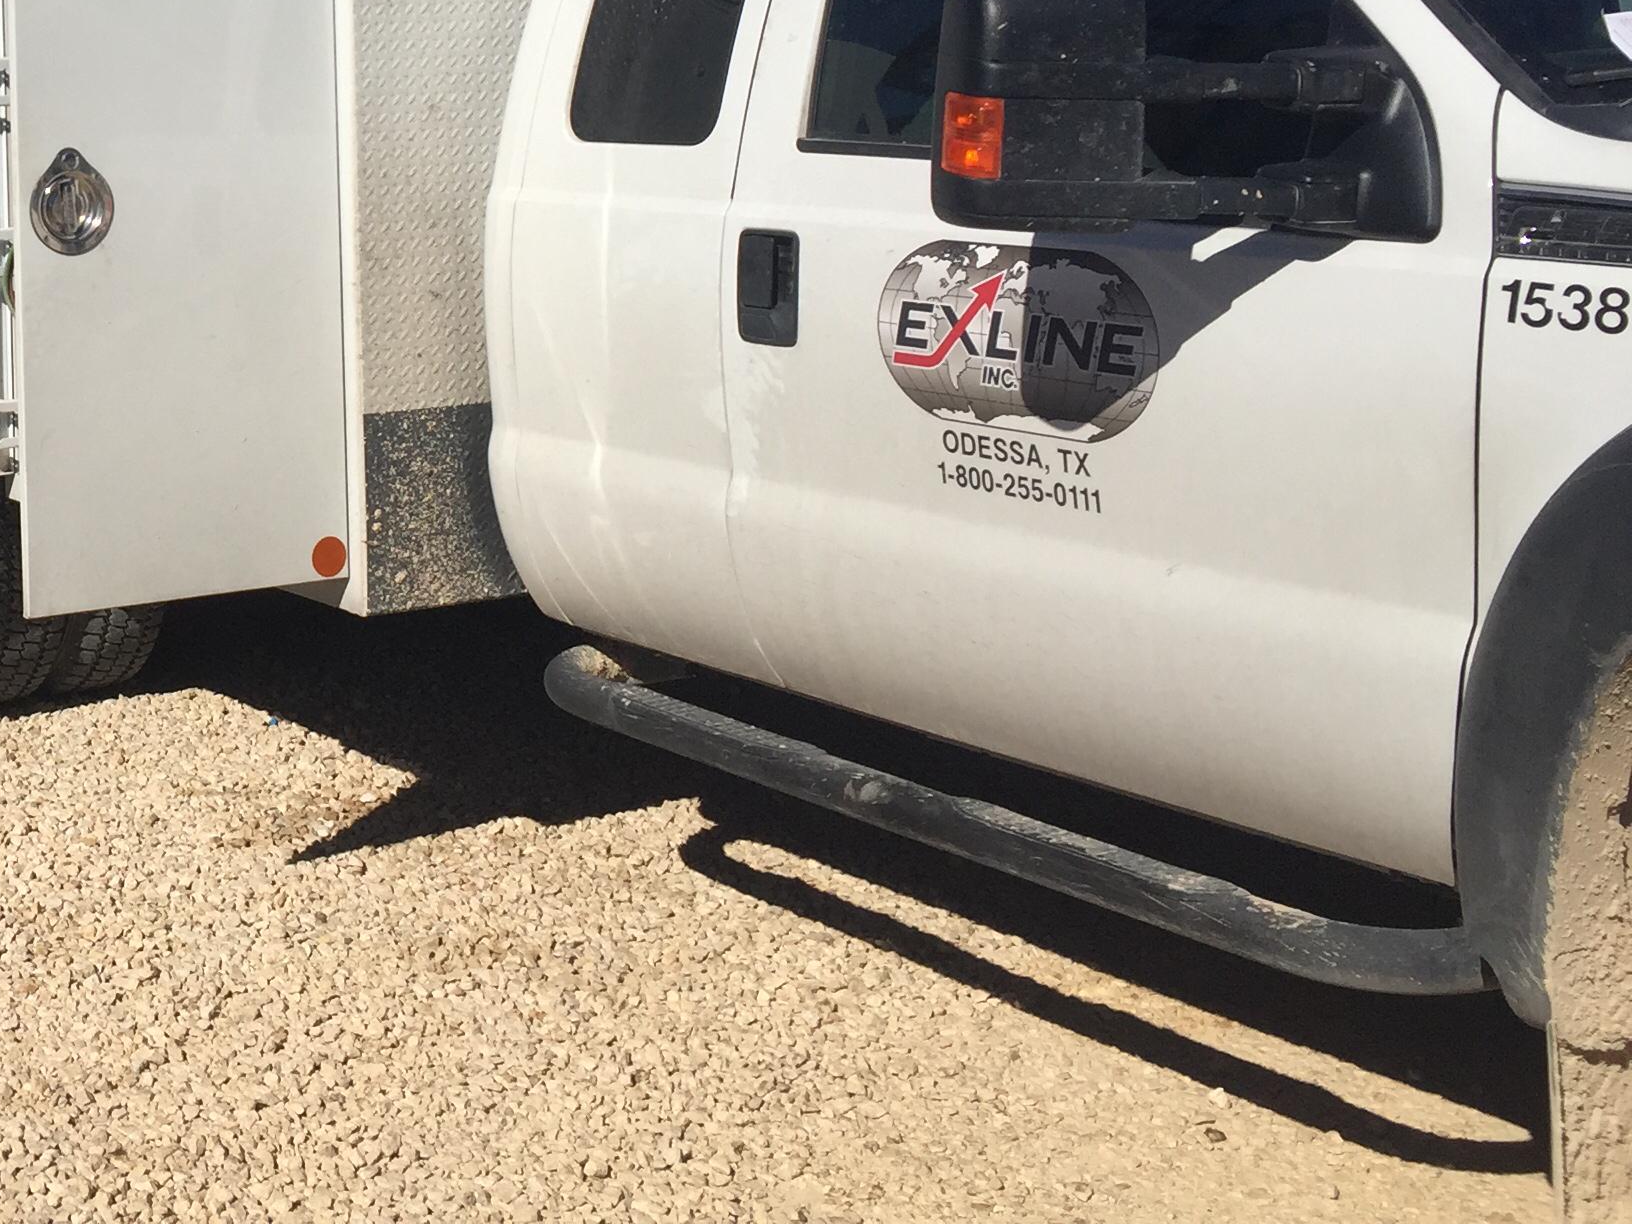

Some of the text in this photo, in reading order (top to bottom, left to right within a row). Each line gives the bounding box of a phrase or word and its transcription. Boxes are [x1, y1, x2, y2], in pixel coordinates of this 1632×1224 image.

[1501, 278, 1631, 335] 1538
[894, 299, 1144, 377] EXLINE
[981, 365, 1018, 389] INC.
[941, 428, 1092, 478] ODESSA, TX
[936, 461, 1103, 514] 1-800-255-0111
